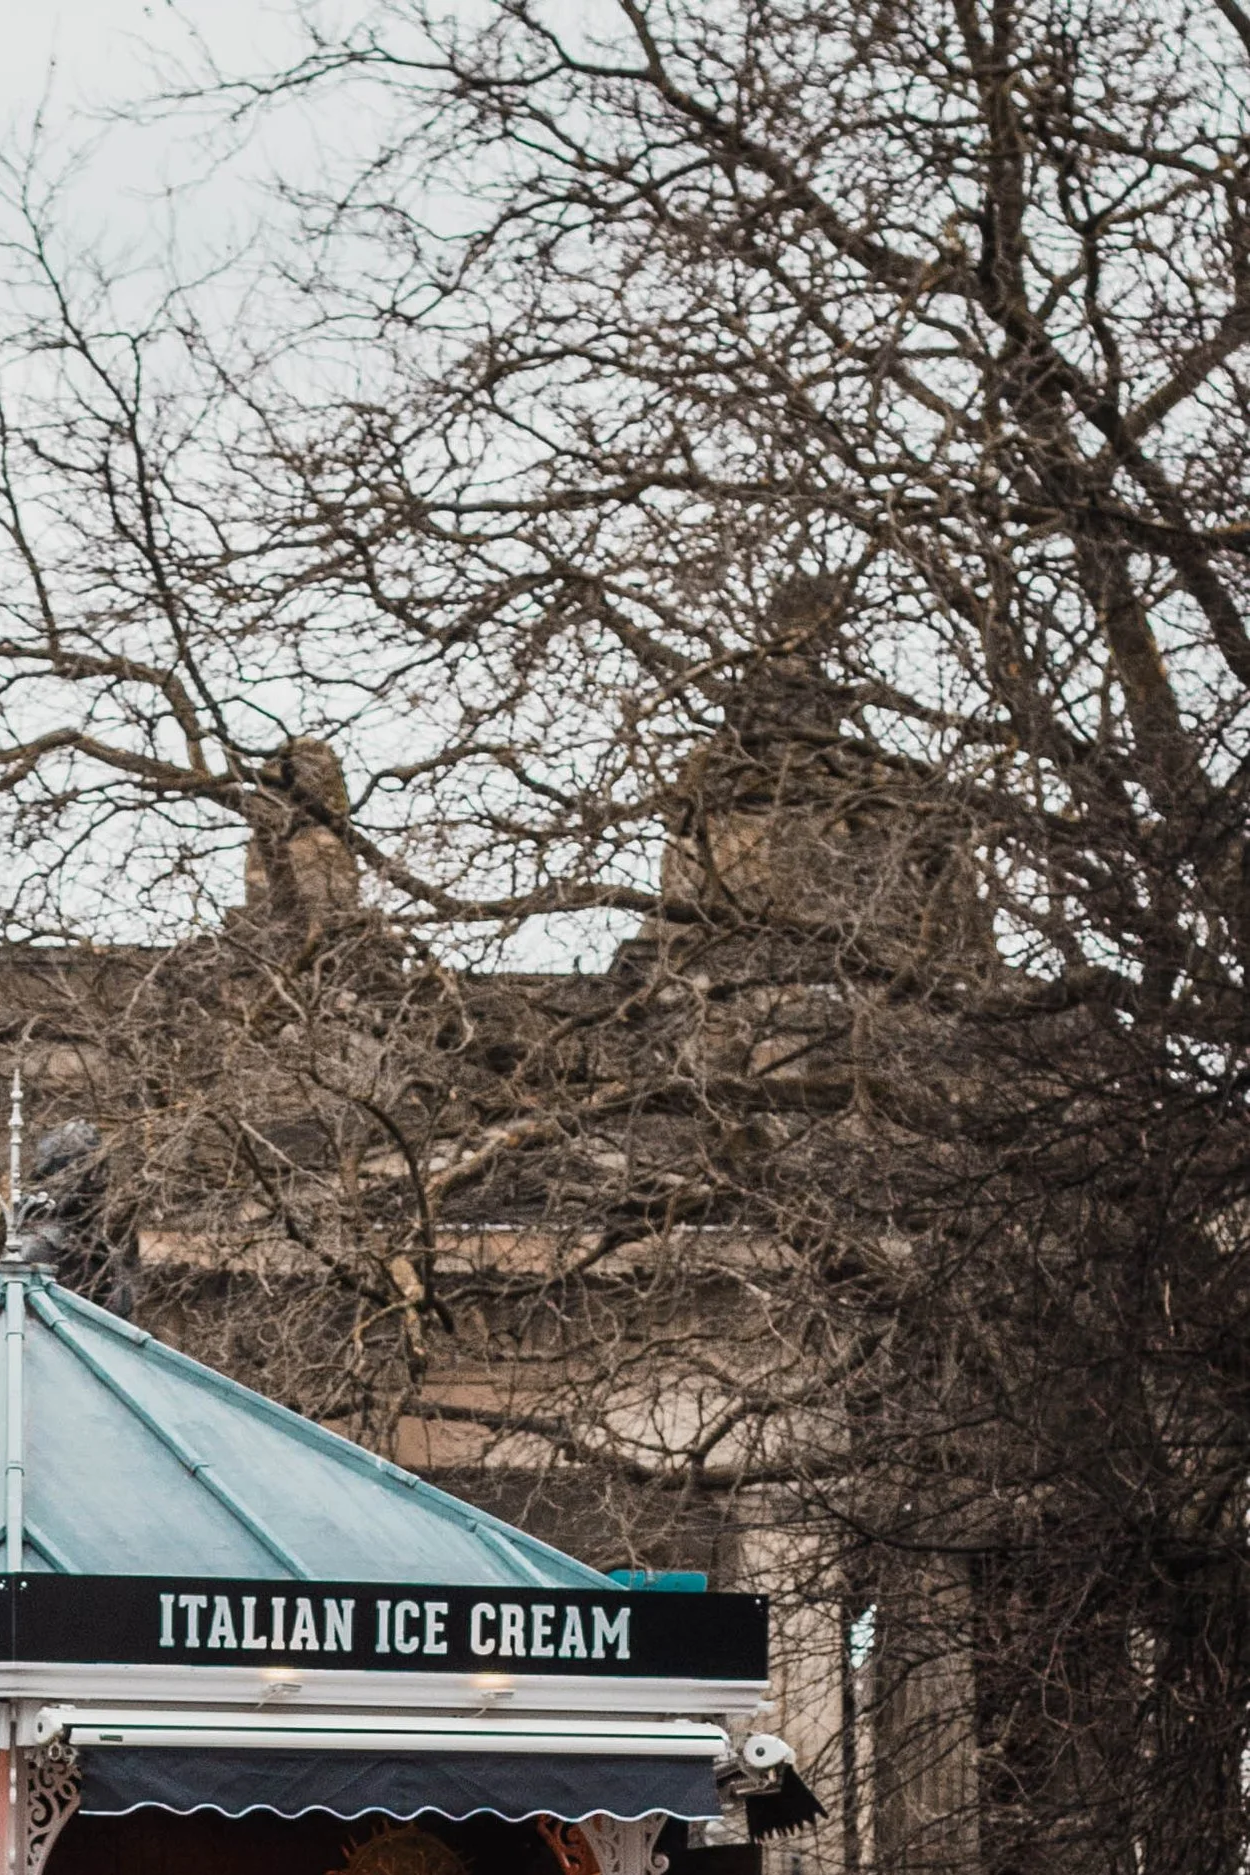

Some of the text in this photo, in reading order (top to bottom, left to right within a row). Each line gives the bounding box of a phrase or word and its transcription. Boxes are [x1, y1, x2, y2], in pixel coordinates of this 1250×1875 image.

[159, 1594, 631, 1659] ITALIAN ICE CREAM
